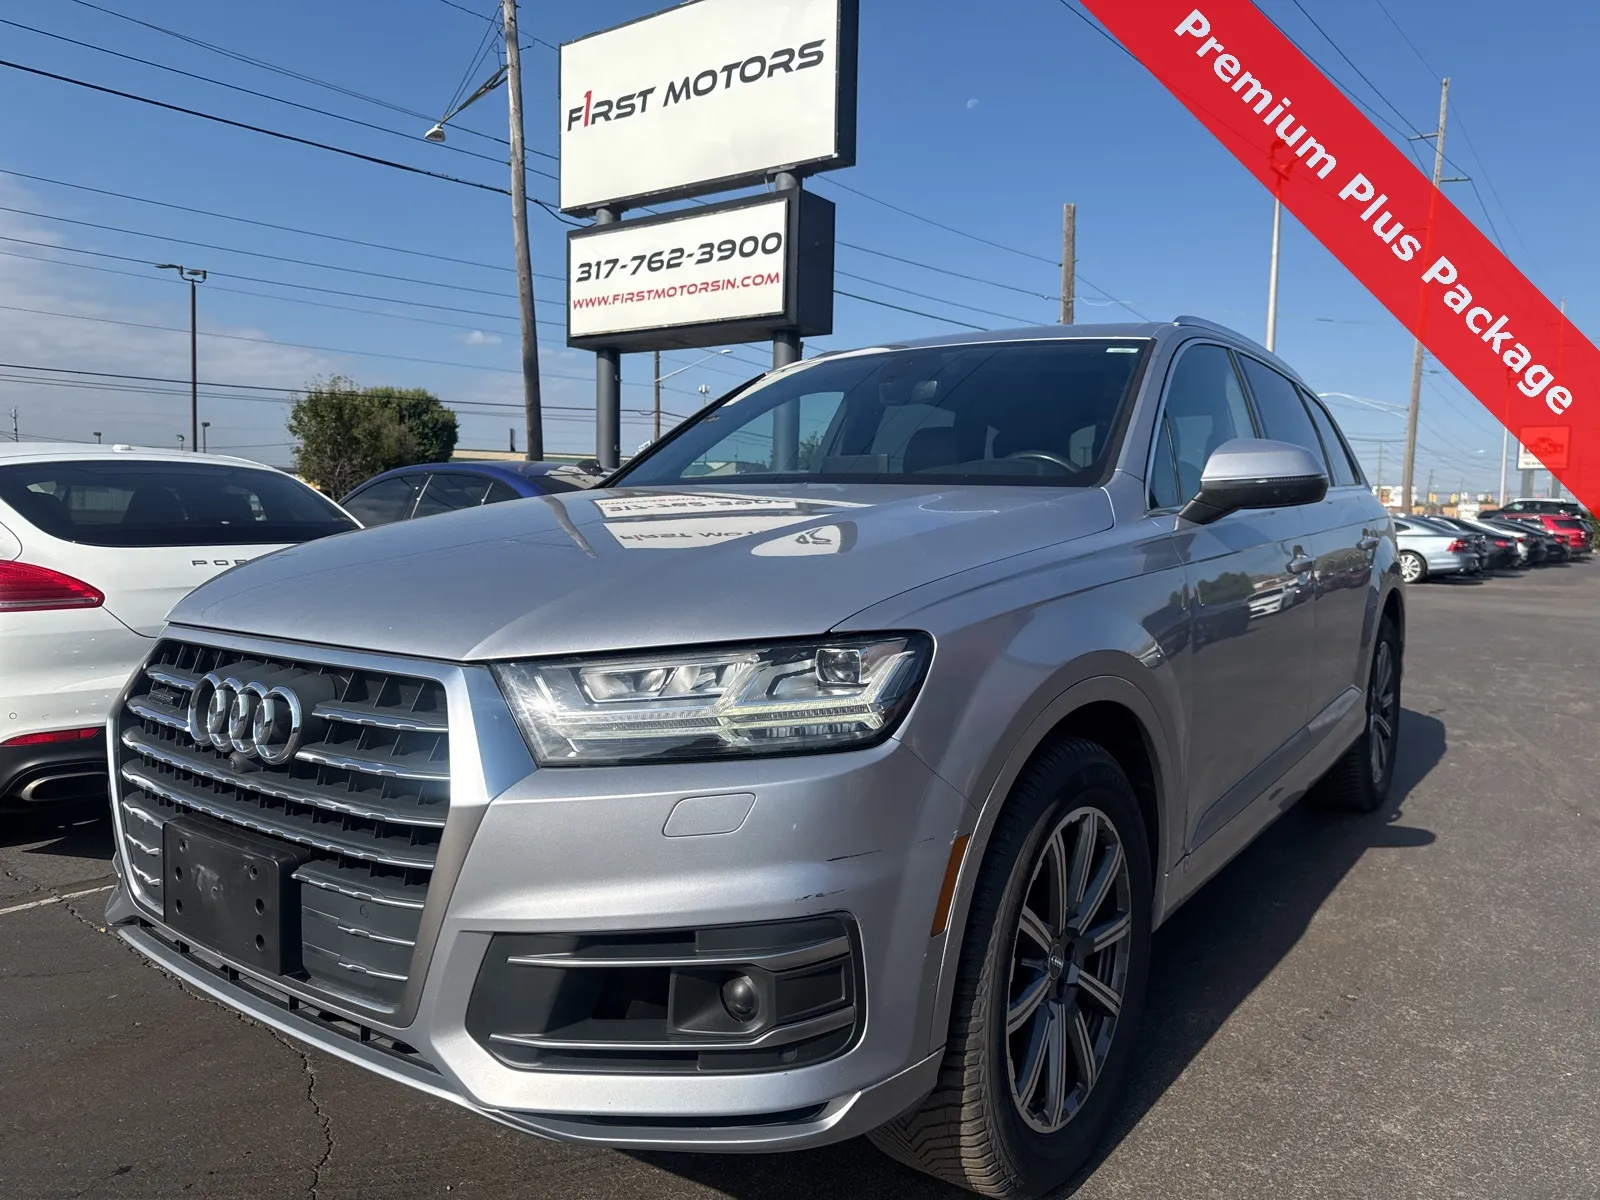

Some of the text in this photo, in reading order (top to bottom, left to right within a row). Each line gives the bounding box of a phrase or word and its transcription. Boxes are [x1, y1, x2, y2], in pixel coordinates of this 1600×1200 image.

[663, 38, 826, 107] MOTORS
[575, 232, 783, 283] 317-762-3900
[572, 271, 780, 310] WWW.FIRSTMOTORSIN.COM
